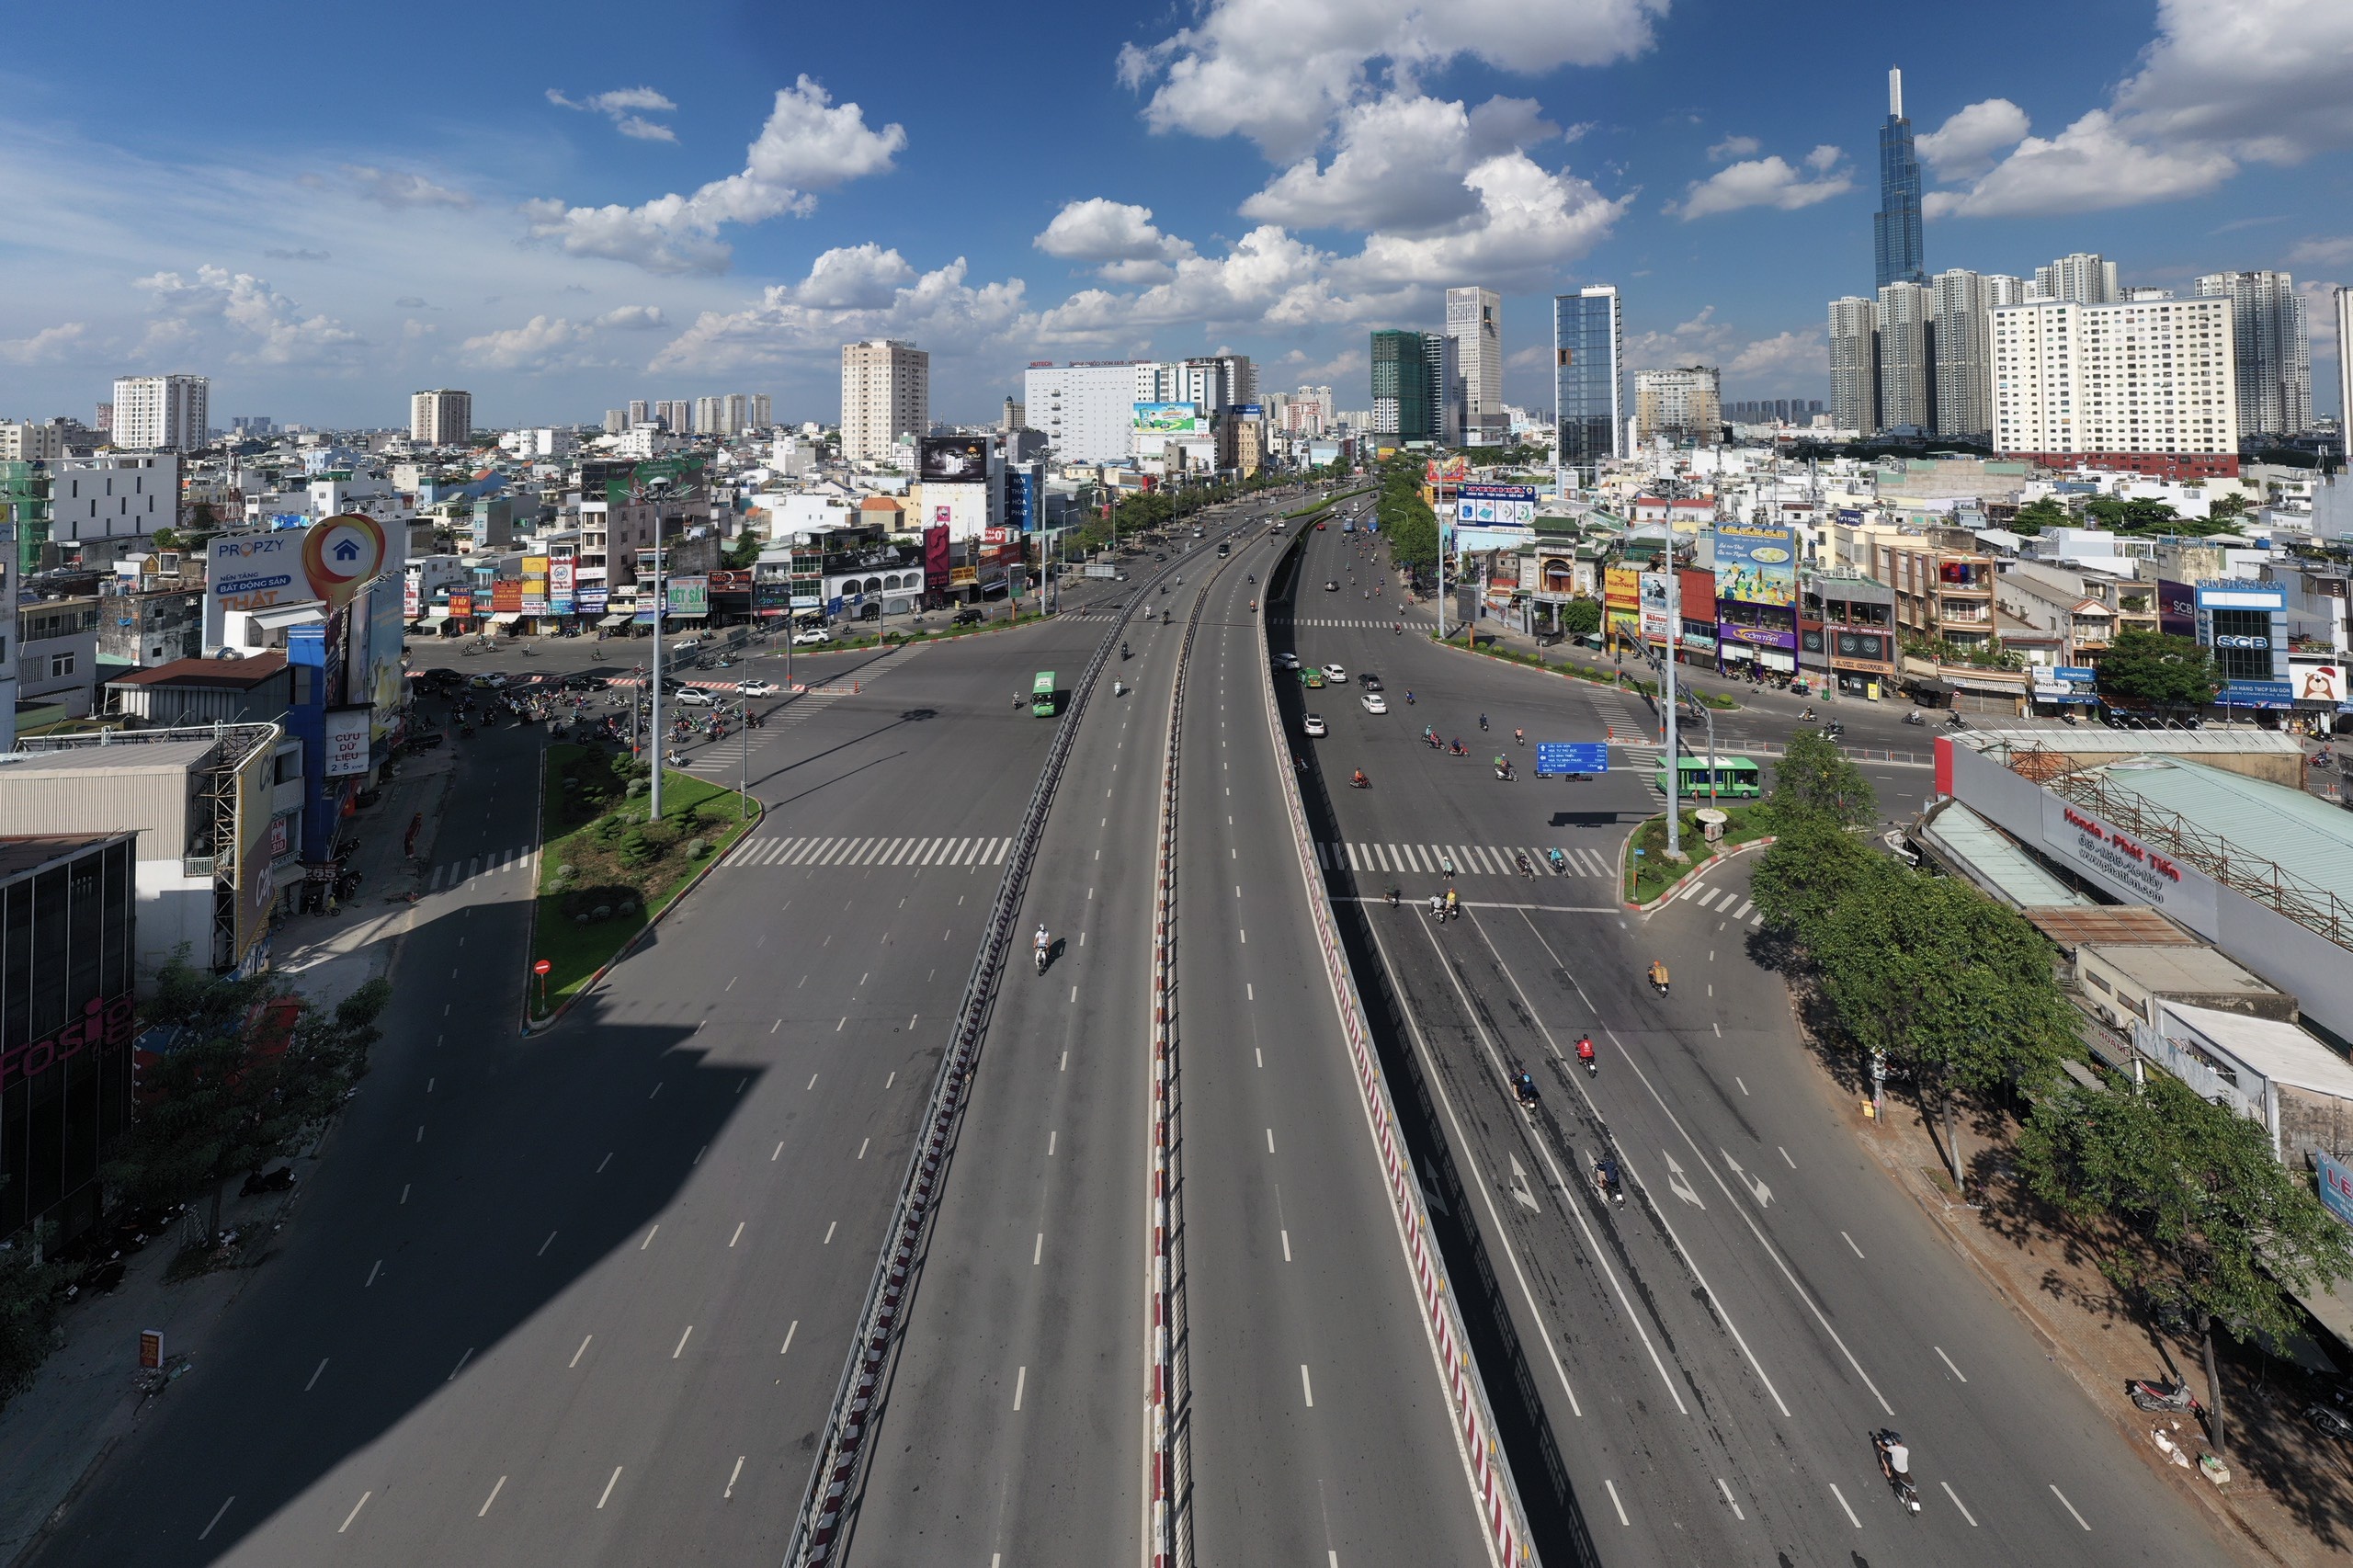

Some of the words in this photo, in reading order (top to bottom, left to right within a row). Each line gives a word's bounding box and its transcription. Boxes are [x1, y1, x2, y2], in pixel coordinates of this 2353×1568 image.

[219, 539, 284, 558] PROPZY
[2173, 600, 2193, 615] SCB
[2216, 634, 2268, 650] SCB
[2063, 807, 2104, 841] Honda
[2112, 834, 2145, 863] Phát
[2147, 853, 2182, 882] Tiến
